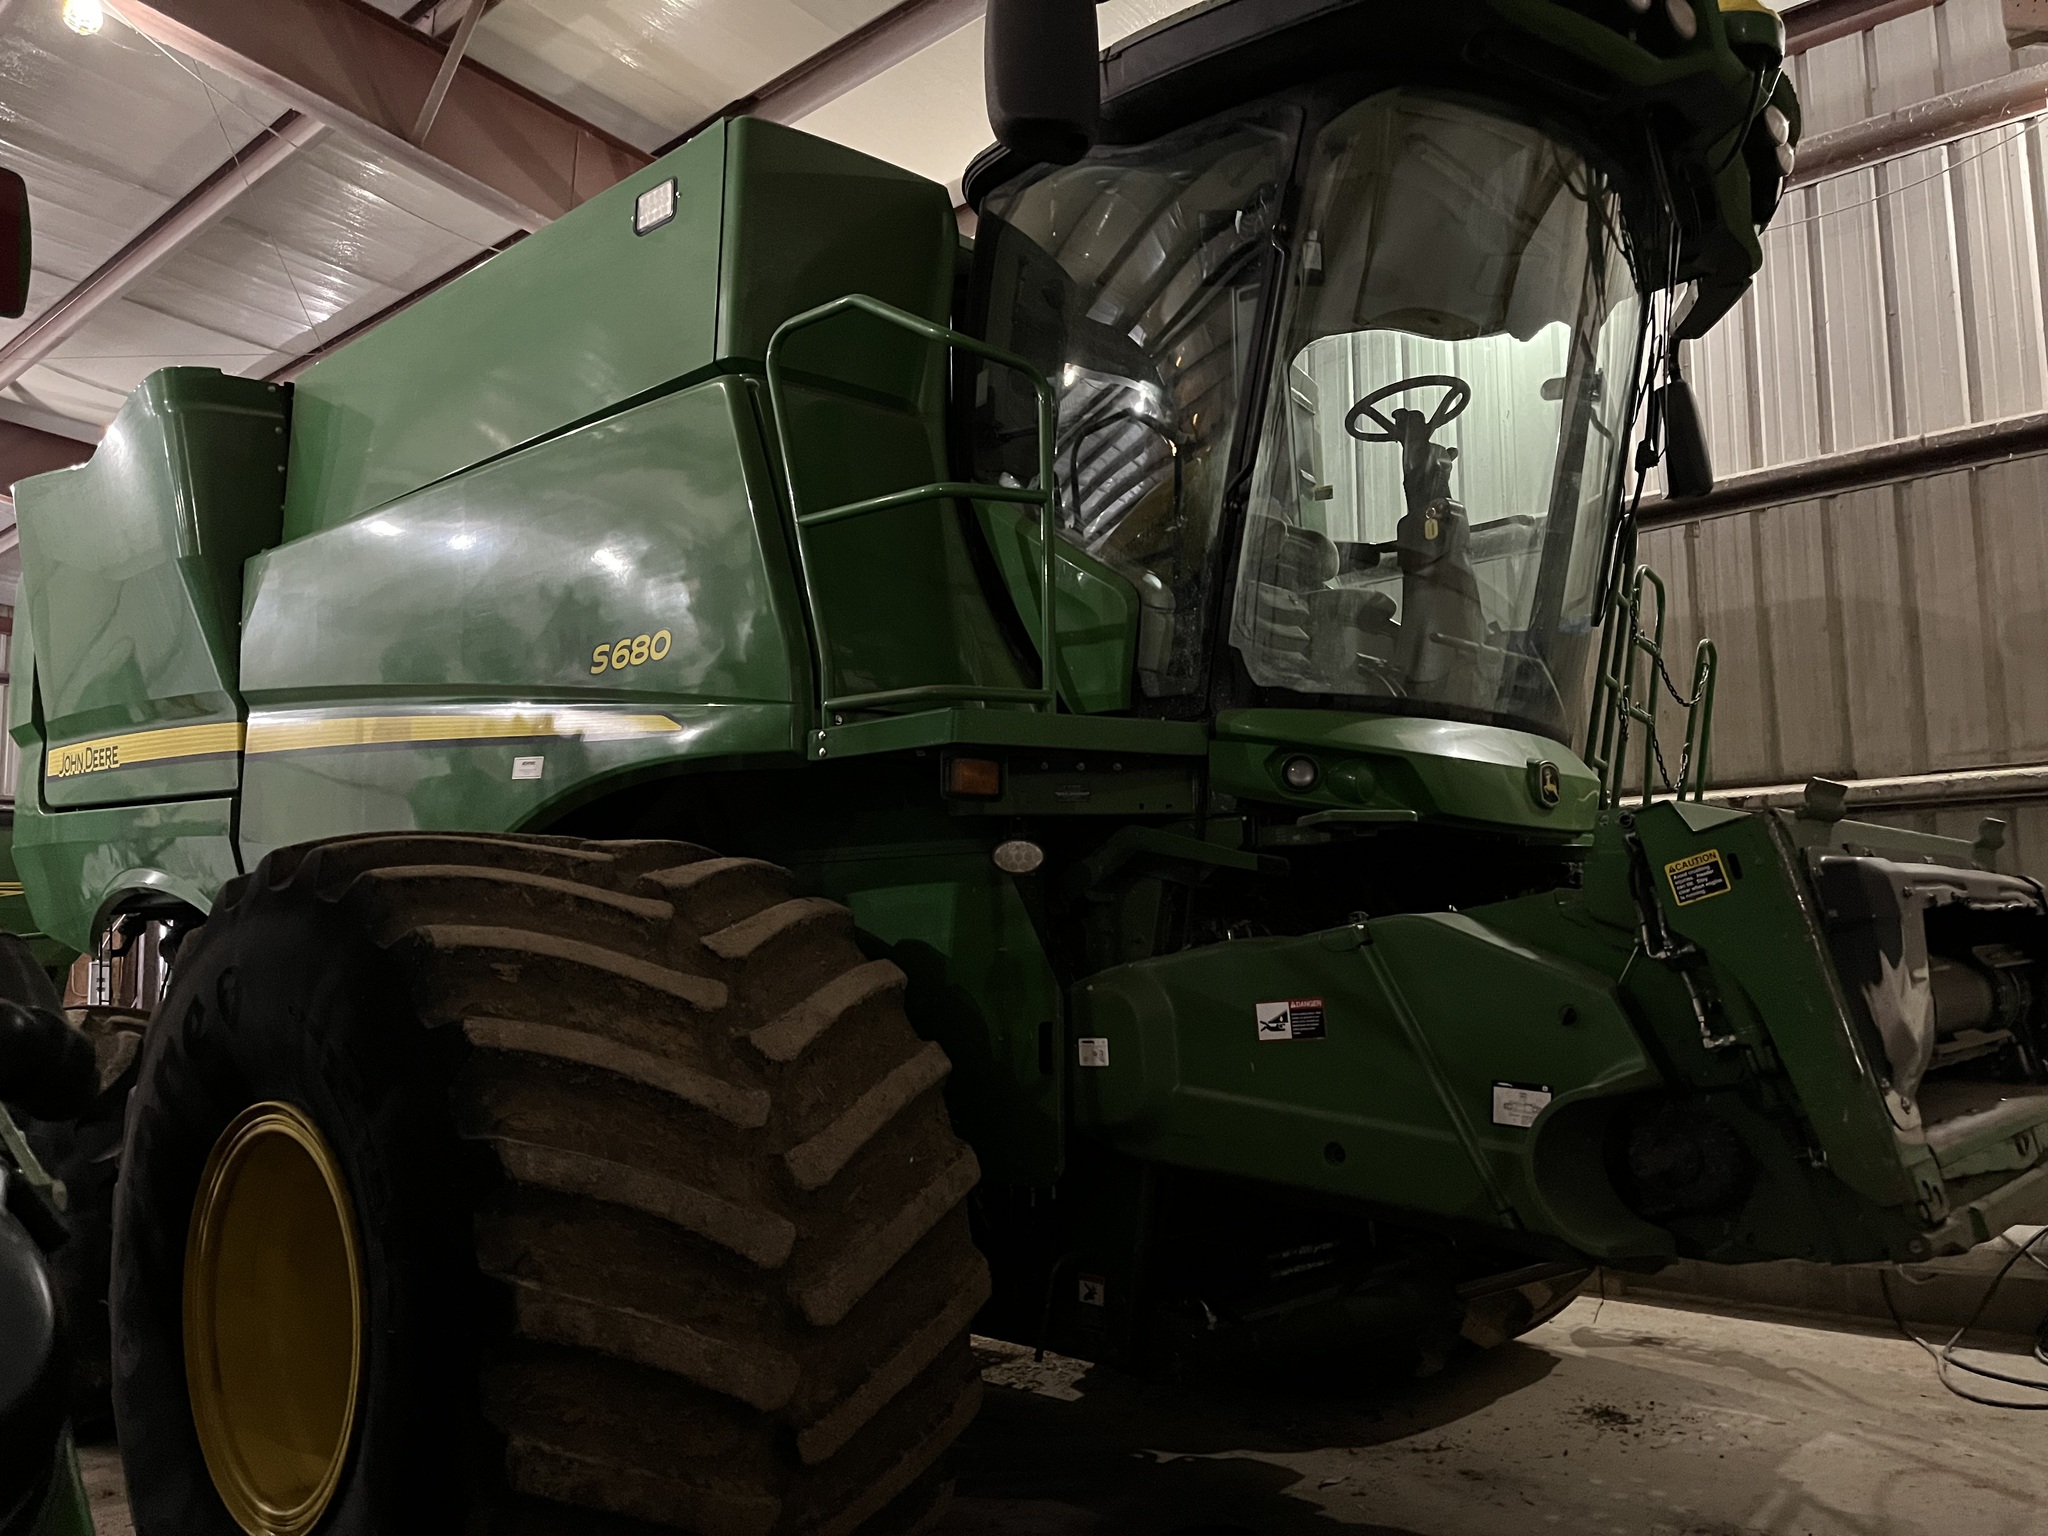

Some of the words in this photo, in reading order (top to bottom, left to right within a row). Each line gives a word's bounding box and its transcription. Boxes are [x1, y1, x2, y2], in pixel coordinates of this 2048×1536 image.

[590, 628, 672, 675] S680
[59, 752, 84, 776] JOHN
[85, 745, 120, 771] DEERE
[1675, 851, 1717, 871] CAUTION
[1295, 1000, 1322, 1008] DANGER
